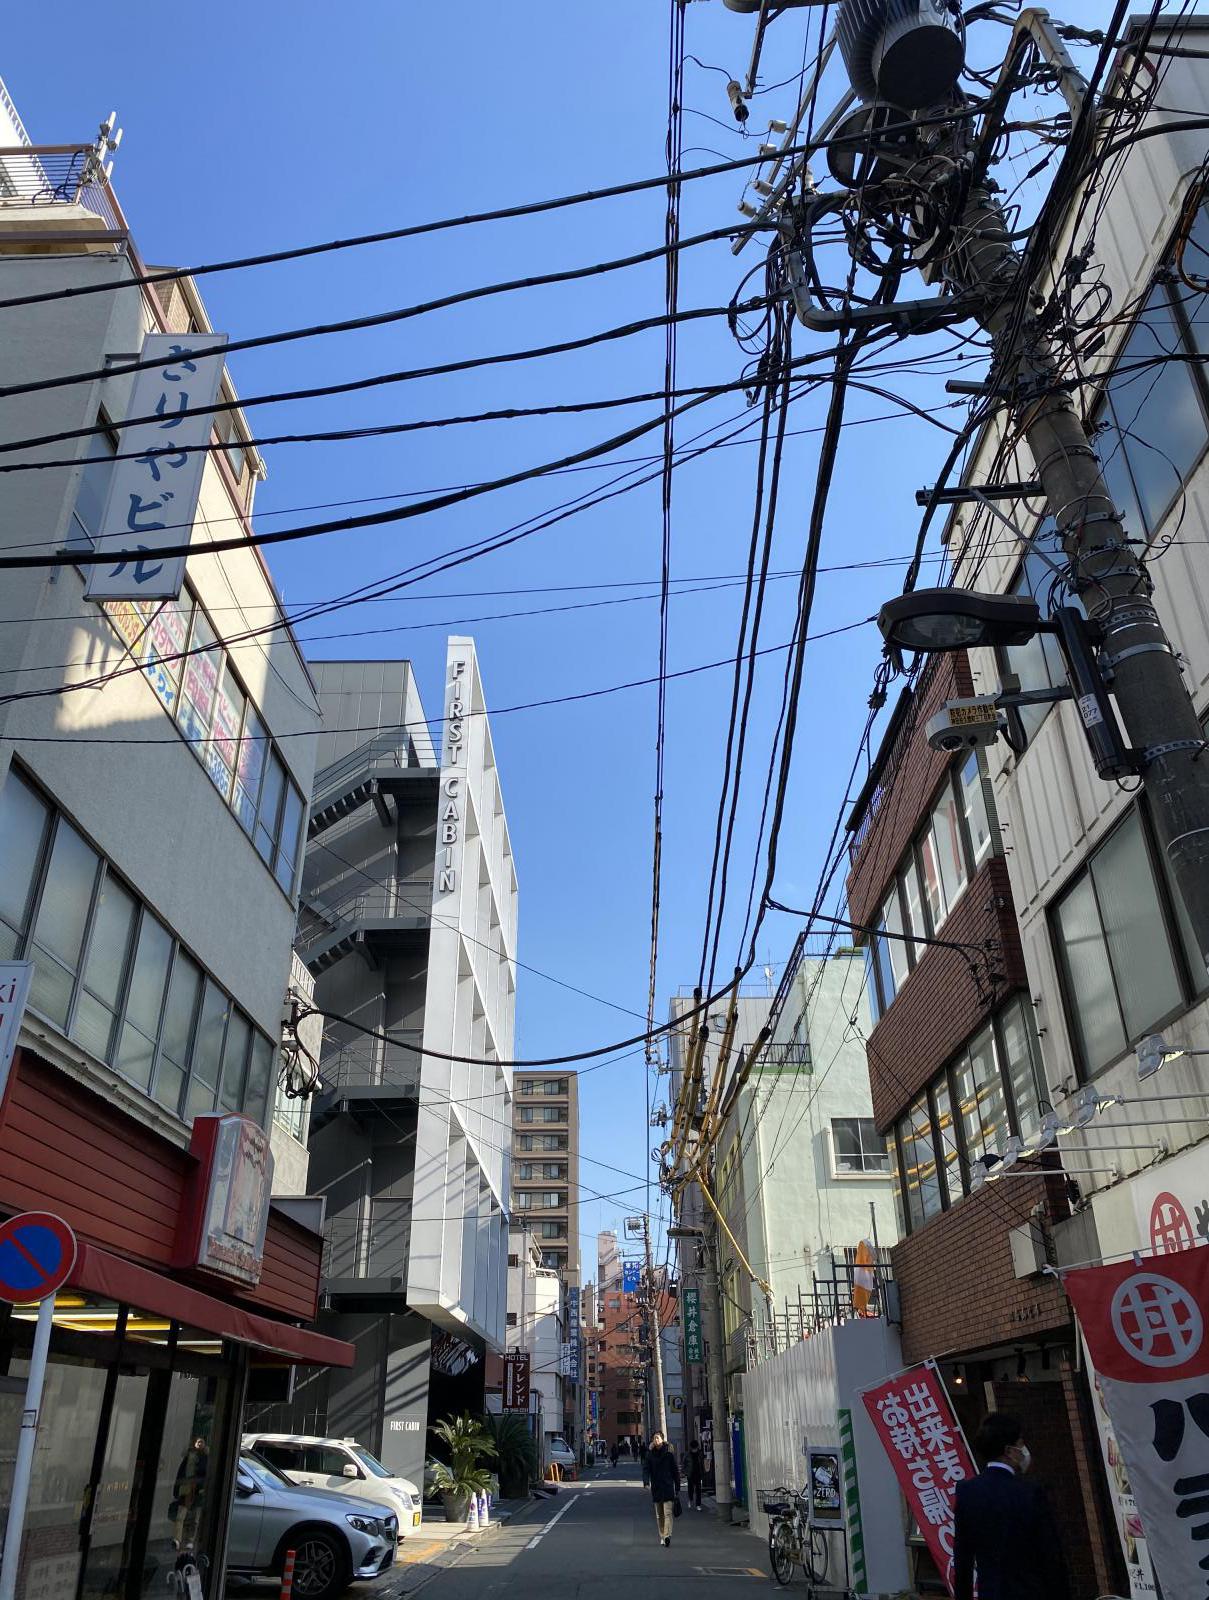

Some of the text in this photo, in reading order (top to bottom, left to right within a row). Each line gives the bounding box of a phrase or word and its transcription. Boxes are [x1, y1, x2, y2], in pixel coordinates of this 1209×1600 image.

[1083, 707, 1098, 719] 077
[439, 660, 465, 892] FIRST CABIN
[515, 1363, 526, 1405] フレンド
[390, 1421, 420, 1431] FIRST CABIN
